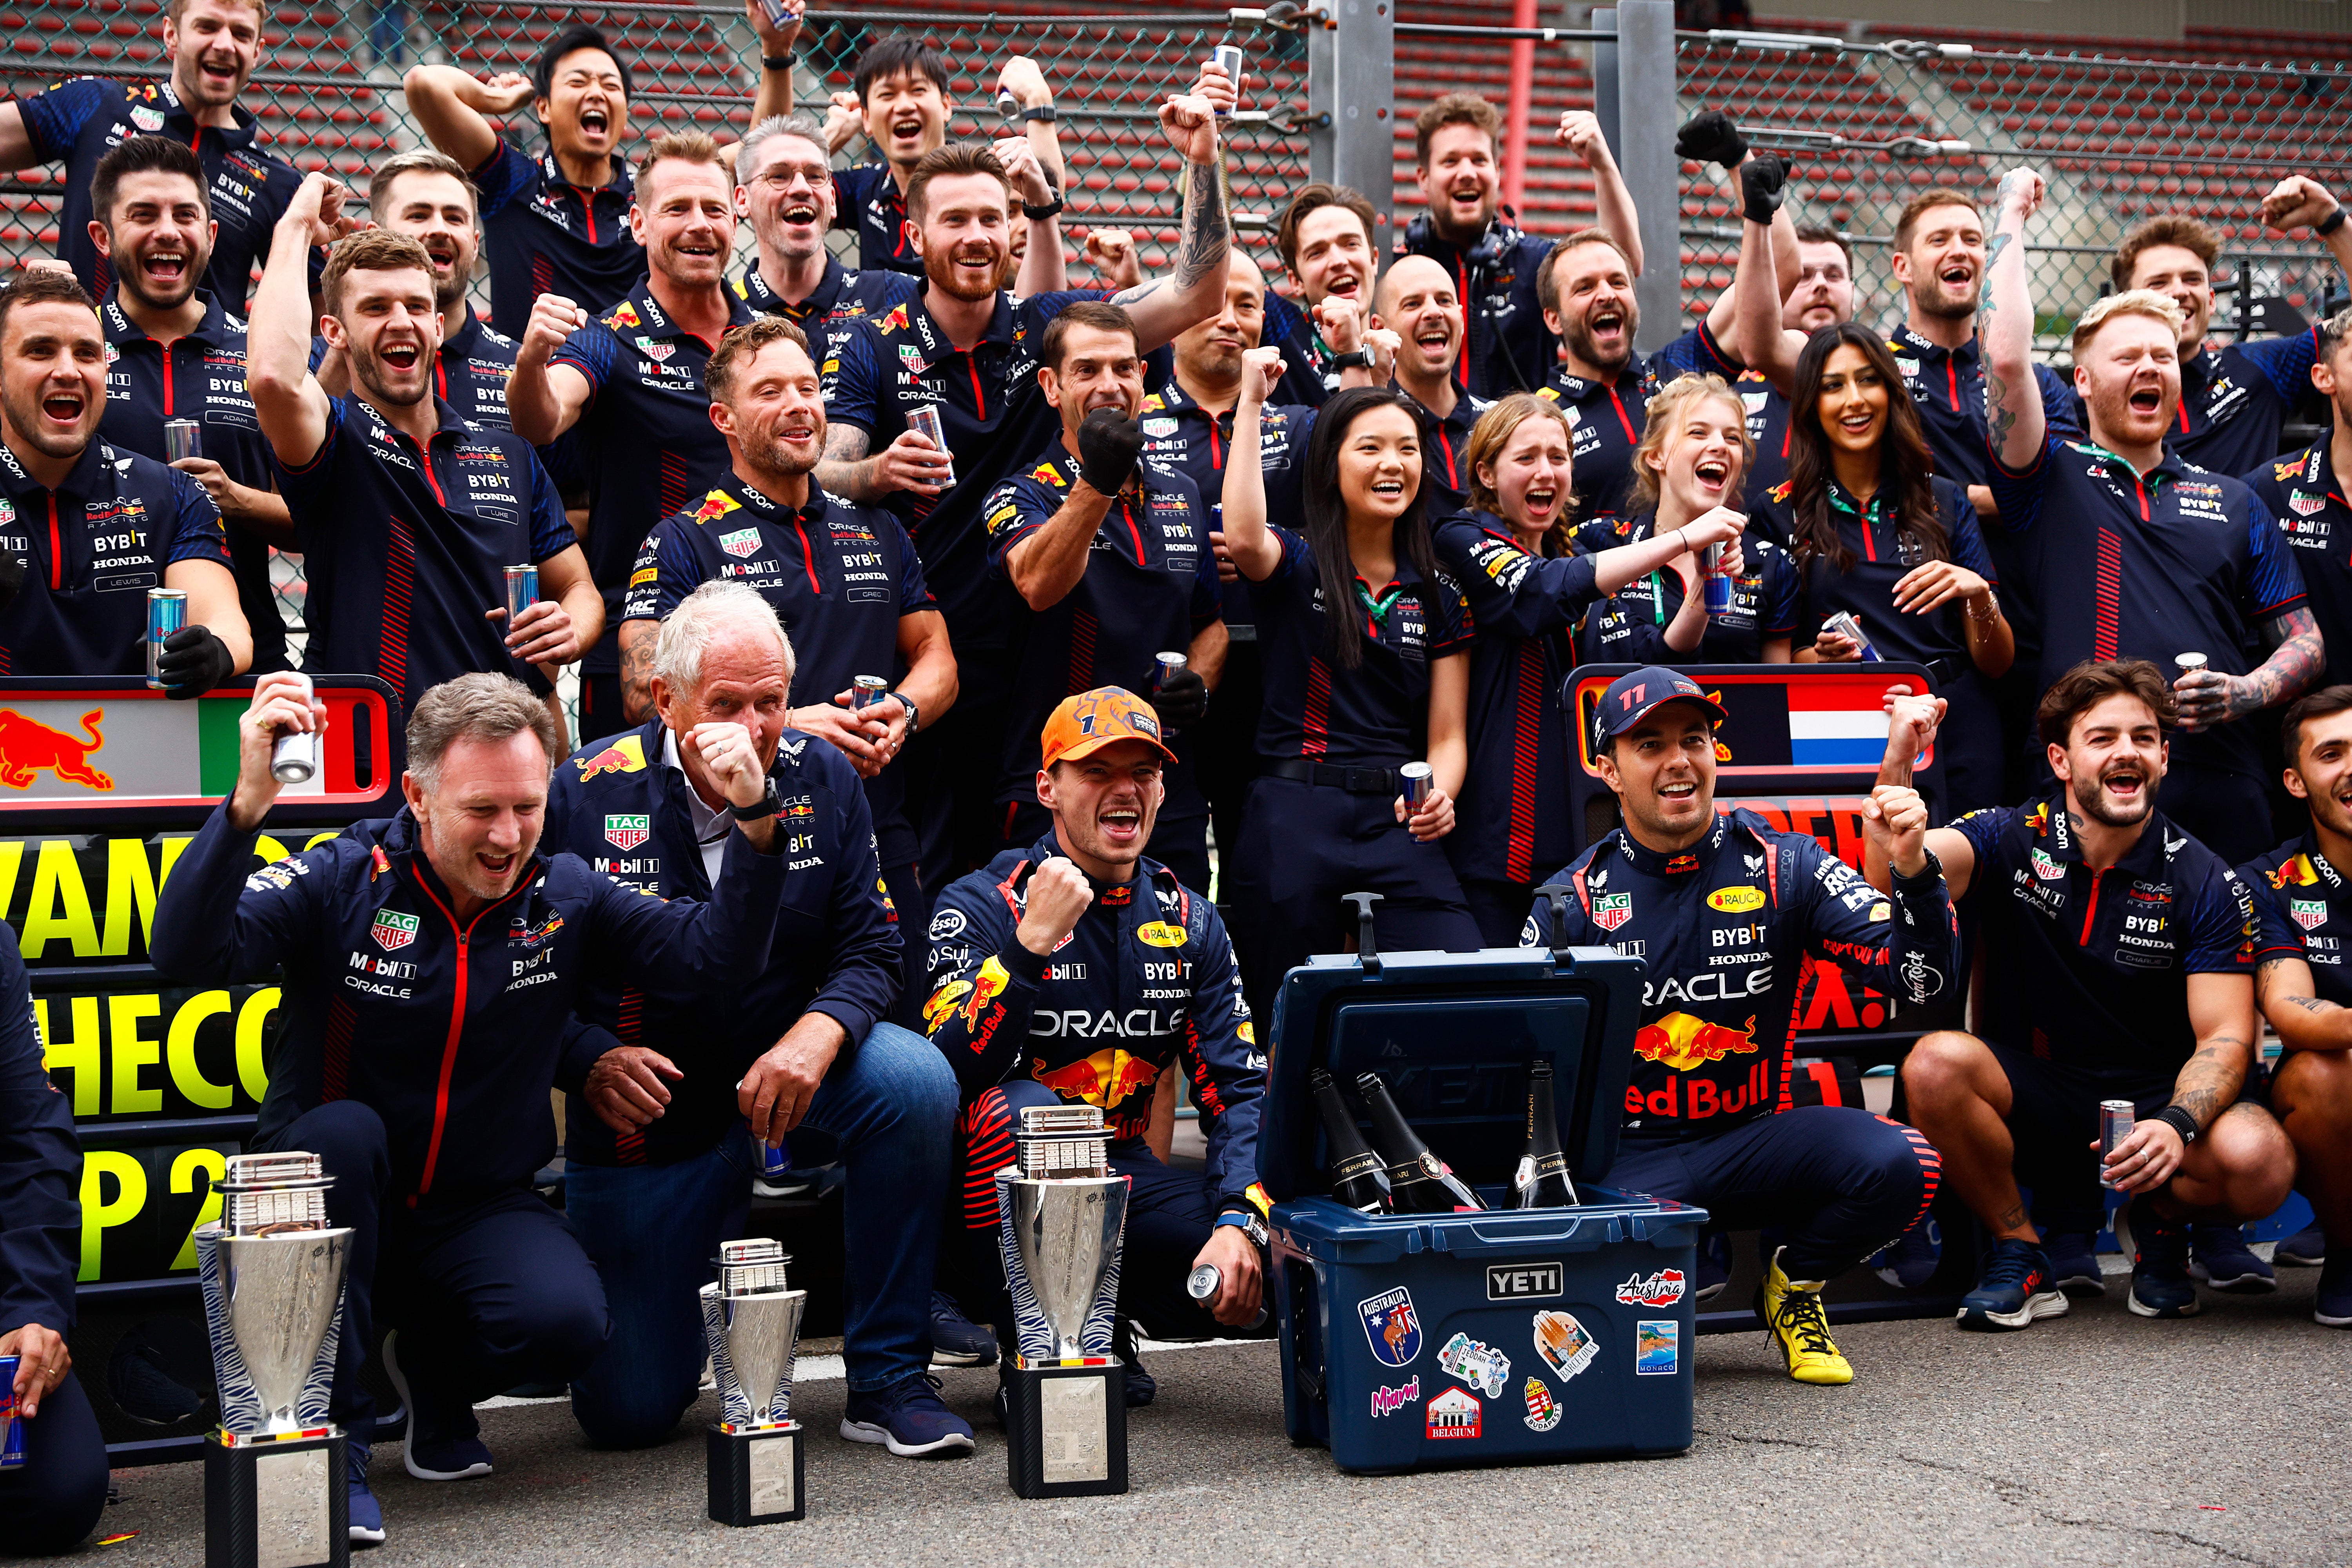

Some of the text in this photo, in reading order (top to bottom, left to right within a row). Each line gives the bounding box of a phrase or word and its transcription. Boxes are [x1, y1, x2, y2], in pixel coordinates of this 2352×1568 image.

[161, 82, 179, 108] zoom
[230, 151, 269, 174] ORACLE
[218, 172, 256, 203] BYBIT
[210, 186, 252, 216] HONDA
[750, 270, 769, 298] zoom
[106, 301, 127, 332] zoom
[643, 296, 665, 328] zoom
[916, 314, 935, 351] zoom
[1904, 331, 1933, 350] zoom
[641, 377, 694, 390] ORACLE
[1559, 374, 1583, 390] zoom
[1165, 382, 1182, 405] zoom
[222, 414, 248, 424] ADAM
[358, 402, 387, 428] zoom
[368, 444, 415, 470] ORACL
[454, 445, 502, 453] ORACLE
[2307, 450, 2322, 483] zoom
[468, 473, 510, 489] BYBIT
[86, 496, 143, 510] ORACLE
[469, 492, 518, 504] HONDA
[1149, 493, 1186, 502] ORACLE
[2180, 497, 2221, 513] BYBIT
[88, 515, 149, 529] RACING
[491, 510, 509, 519] LUKE
[2179, 508, 2229, 523] HONDA
[828, 522, 870, 532] ORACLE
[1162, 523, 1193, 538] BYBIT
[2278, 518, 2314, 534] Mobil
[94, 530, 147, 552] BYBIT
[722, 530, 756, 543] TAG
[725, 540, 761, 555] HEUER
[1165, 543, 1198, 552] HONDA
[1479, 546, 1512, 566] Claro
[93, 555, 154, 570] HONDA
[842, 552, 882, 568] BYBIT
[721, 561, 764, 578] Mobil
[844, 572, 889, 581] HONDA
[111, 577, 141, 586] LEWIS
[1619, 683, 1646, 711] 11
[1080, 714, 1096, 735] 1
[609, 817, 645, 828] TAG
[2055, 811, 2068, 849] zoom
[607, 831, 647, 847] HEUER
[595, 858, 641, 873] Mobil
[1682, 862, 1699, 873] Bull
[2313, 853, 2342, 888] zoom
[2014, 869, 2049, 900] Mobil
[1102, 895, 1131, 905] Red Bull
[1596, 896, 1627, 911] TAG
[1725, 893, 1761, 905] RAUCH
[2013, 887, 2057, 920] ORACLE
[2293, 903, 2323, 913] TAG
[380, 911, 415, 929] TAG
[1595, 910, 1631, 929] HEUER
[373, 926, 412, 948] HEUER
[1712, 923, 1766, 947] BYBIT
[2119, 934, 2176, 950] HONDA
[941, 944, 969, 961] Sui
[1709, 951, 1773, 966] HONDA
[2125, 955, 2161, 965] CHARLIE
[349, 951, 398, 977] Mobil
[1144, 959, 1192, 980] BYBIT
[345, 976, 412, 999] ORACLE
[504, 972, 557, 993] HONDA
[1142, 989, 1192, 999] HONDA
[970, 1001, 1007, 1054] Red Bull
[1687, 1059, 1769, 1119] Bull
[1341, 1159, 1375, 1175] FERRARI
[1099, 1189, 1121, 1202] MSC
[76, 1149, 227, 1282] P 2
[1492, 1269, 1556, 1293] YETI
[1619, 1275, 1683, 1299] Austria
[1364, 1290, 1406, 1317] AUSTRALIA
[1462, 1348, 1487, 1364] JEDDAH
[1559, 1343, 1597, 1379] BARCELONA
[1373, 1376, 1418, 1416] Miami
[1528, 1407, 1561, 1430] BUDAPEST
[1432, 1427, 1475, 1438] BELGIUM
